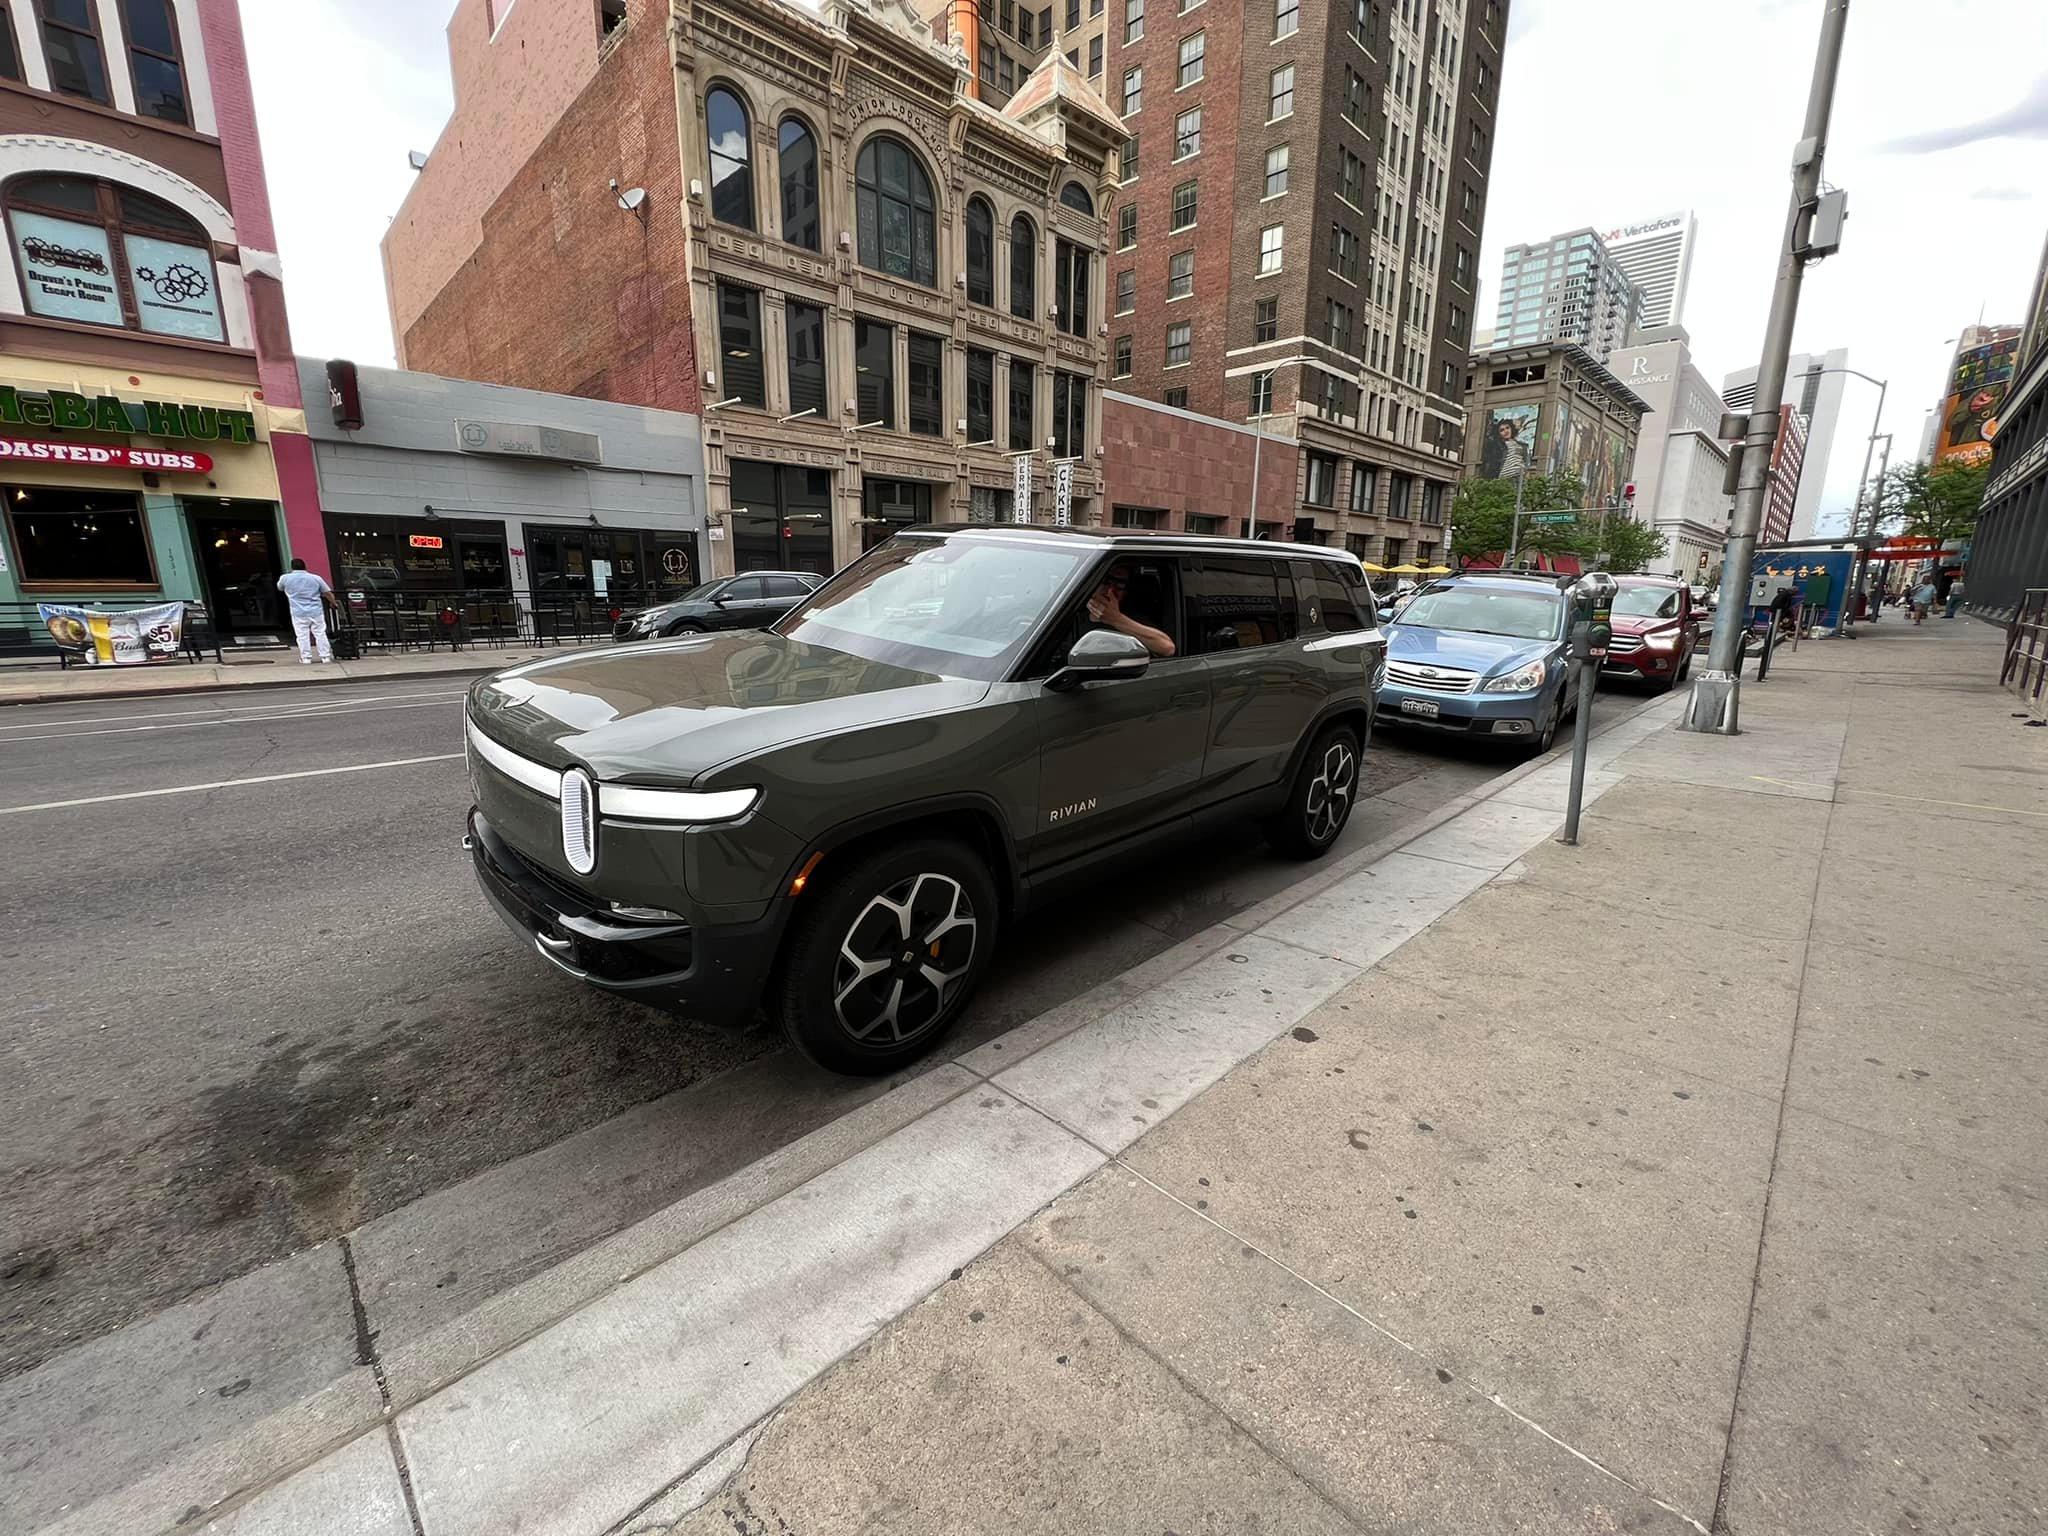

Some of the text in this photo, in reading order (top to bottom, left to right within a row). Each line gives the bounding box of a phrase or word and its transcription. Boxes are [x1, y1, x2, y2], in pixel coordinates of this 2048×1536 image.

[849, 99, 886, 119] UNION
[891, 102, 928, 133] LODGE
[1624, 218, 1681, 237] Vertafore
[1632, 356, 1654, 375] R
[143, 400, 256, 444] HUT
[128, 451, 196, 469] SUBS
[1018, 457, 1026, 524] MERMAIDS
[411, 536, 442, 547] OPEN
[1049, 797, 1097, 822] RIVIAN
